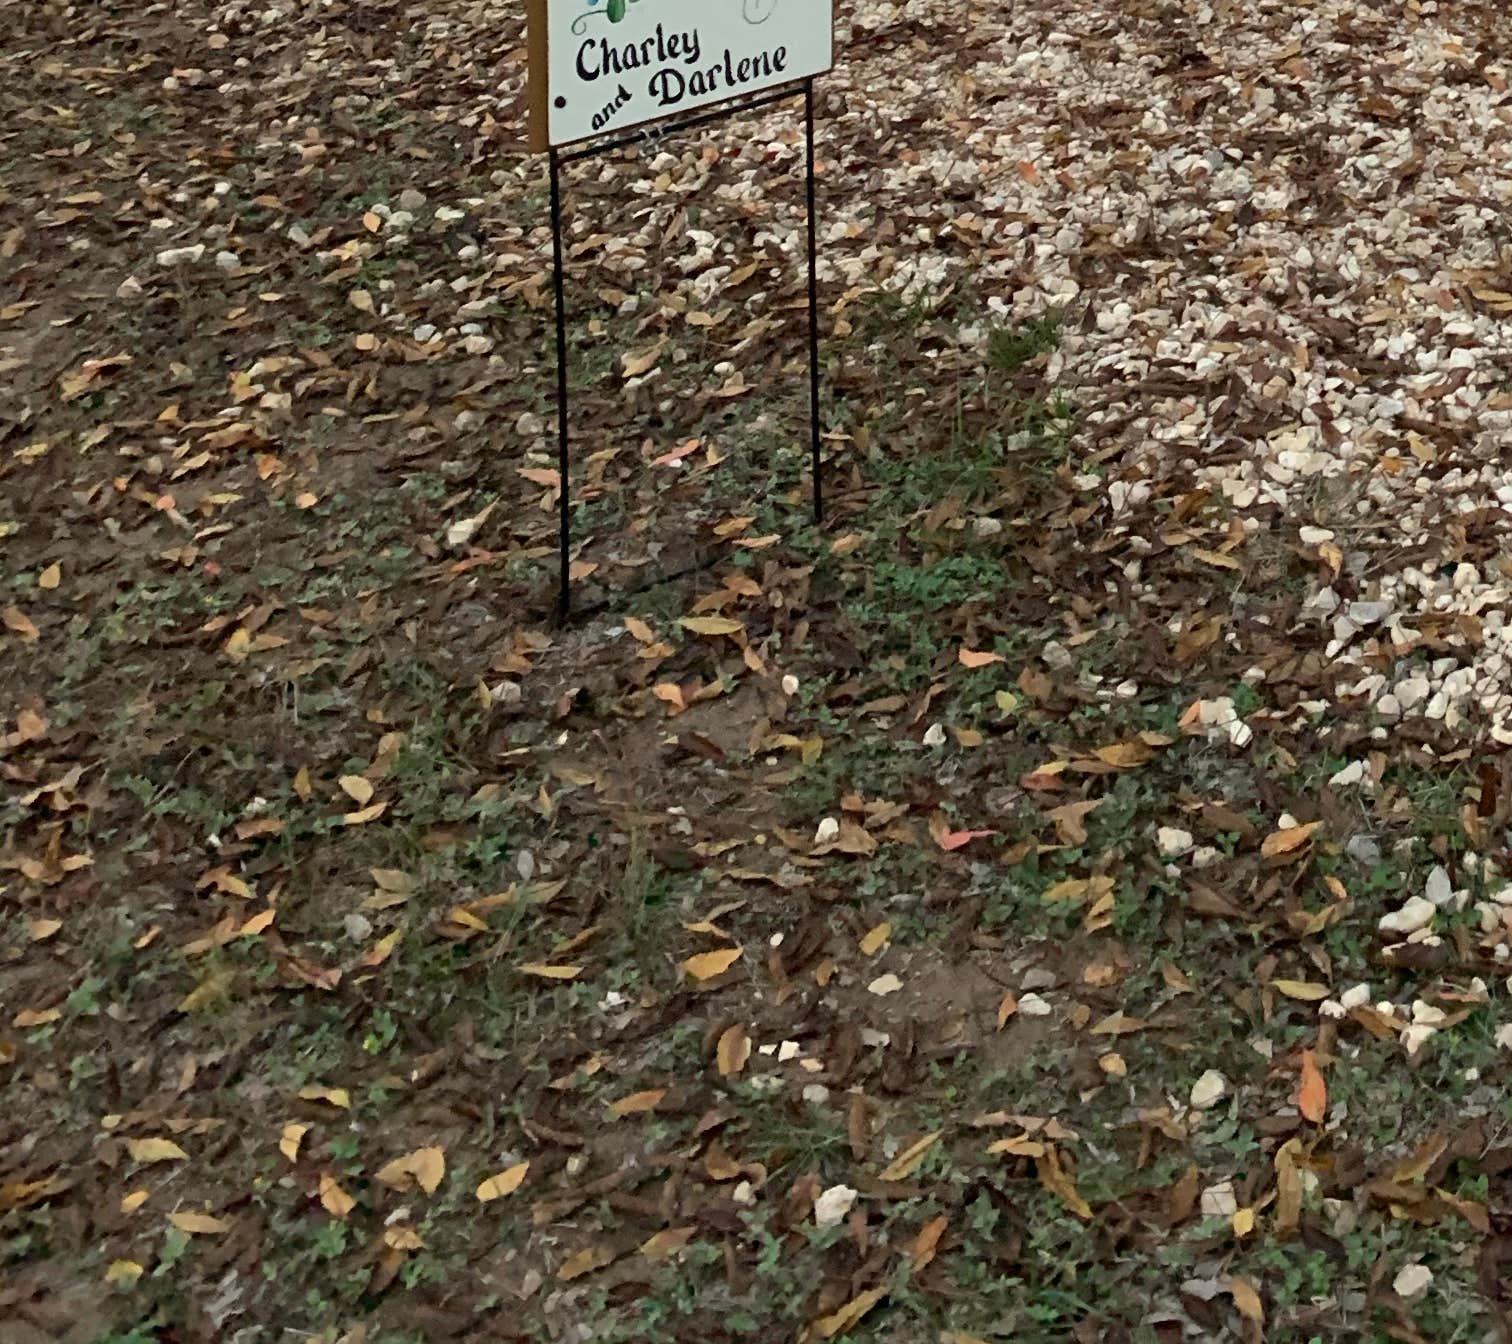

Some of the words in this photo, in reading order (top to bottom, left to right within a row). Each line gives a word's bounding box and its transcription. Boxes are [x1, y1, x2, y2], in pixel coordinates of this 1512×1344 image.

[575, 22, 701, 82] Charley
[590, 83, 633, 131] and
[648, 45, 787, 108] Darlene
